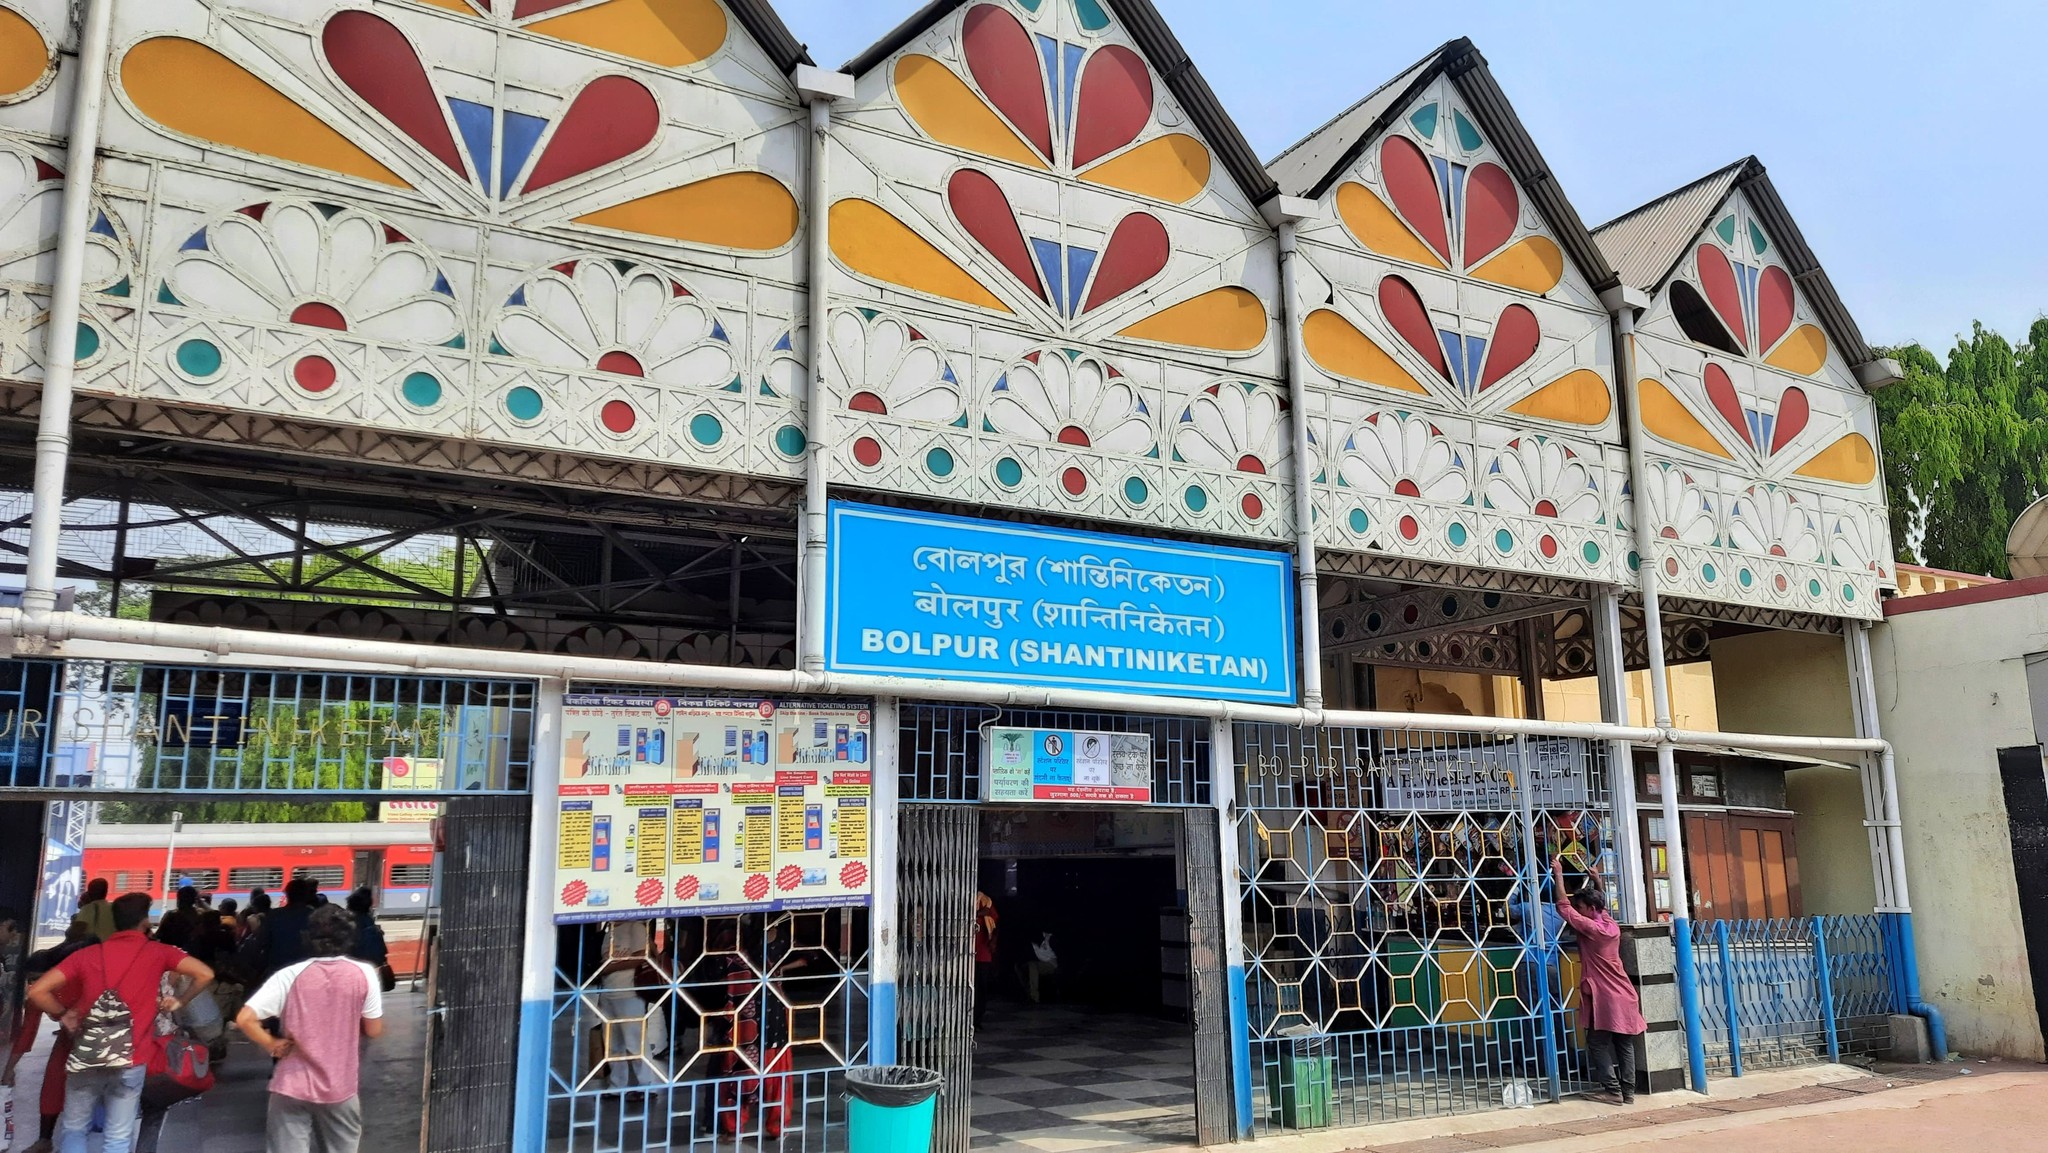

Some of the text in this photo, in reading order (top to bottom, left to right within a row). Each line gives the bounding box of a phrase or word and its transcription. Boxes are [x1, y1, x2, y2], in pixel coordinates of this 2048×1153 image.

[913, 546, 1028, 585] বোলপুর
[913, 582, 1023, 629] बोलपुर
[862, 628, 1269, 684] BOLPUR (SHANTINIKETAN)
[603, 697, 623, 705] टिकट
[1258, 754, 1340, 778] BOLPUR
